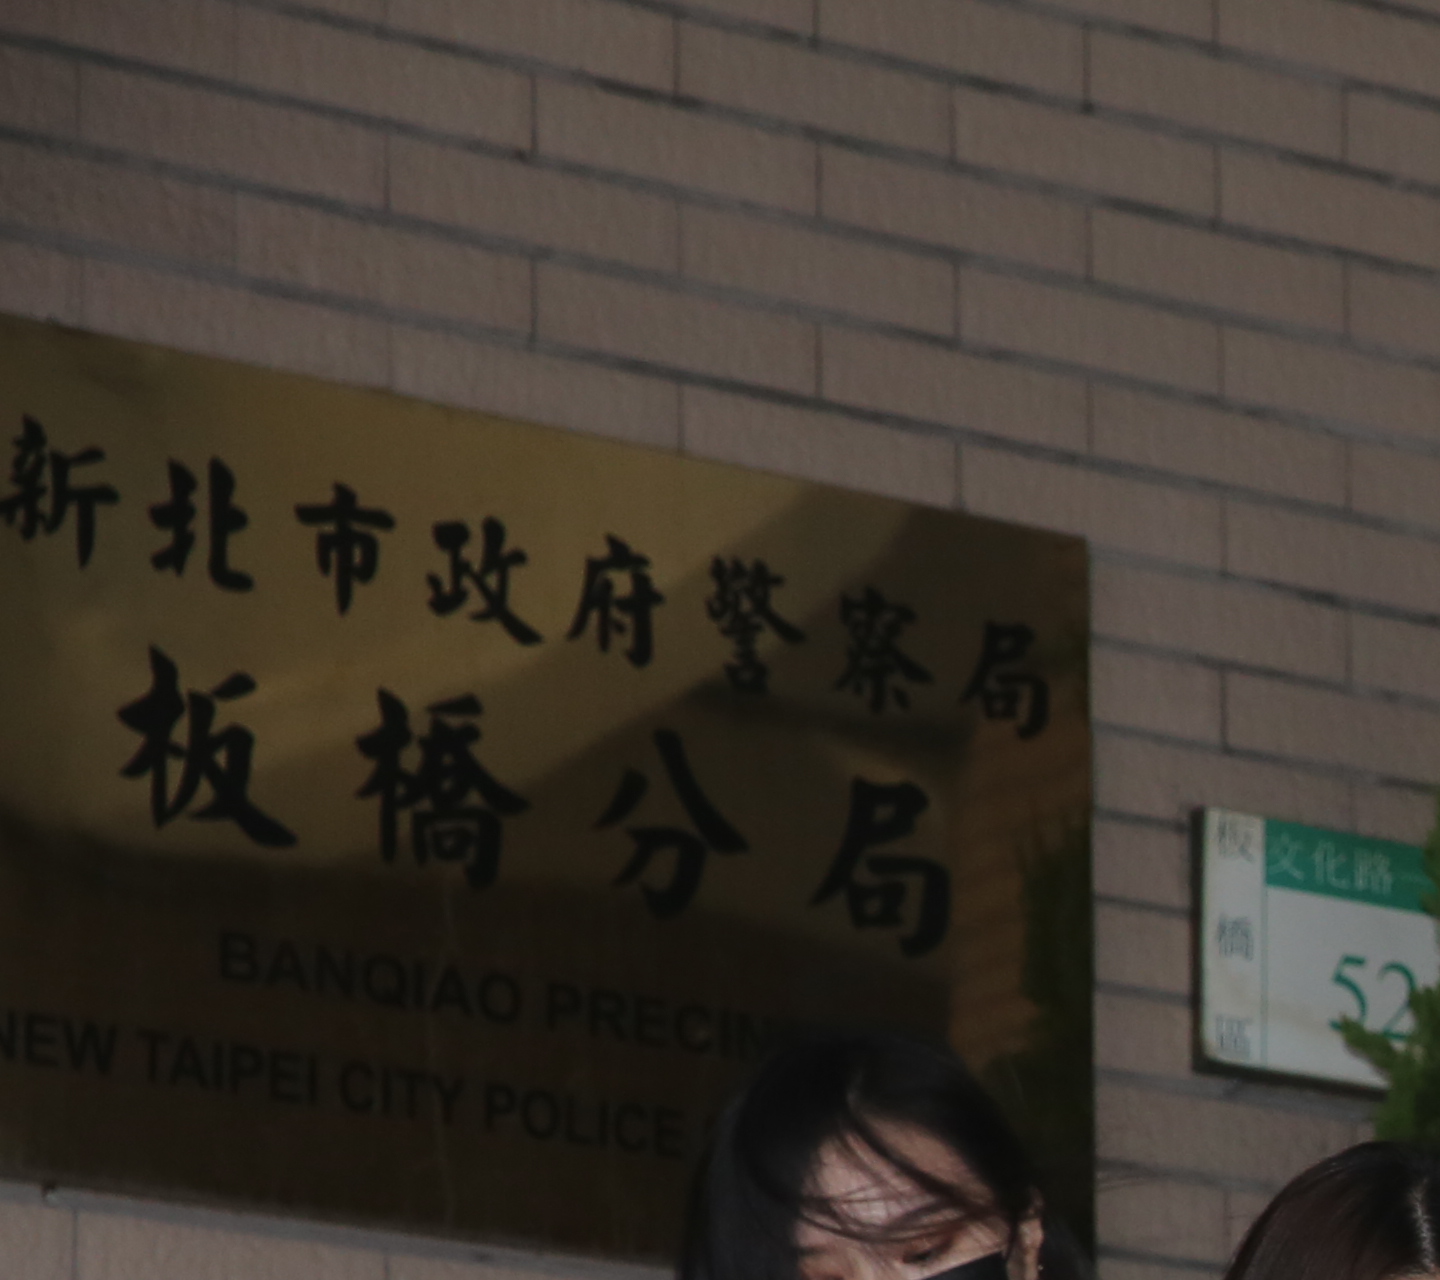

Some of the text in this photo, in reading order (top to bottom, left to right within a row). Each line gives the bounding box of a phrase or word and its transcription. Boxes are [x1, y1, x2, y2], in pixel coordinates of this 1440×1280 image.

[0, 414, 1053, 741] 新北市政府警察局
[116, 643, 954, 960] 板橋分局
[0, 1009, 119, 1077] NEW
[136, 1027, 319, 1108] TAIPEI
[338, 1059, 466, 1126] CITY
[484, 1082, 686, 1160] POLICE
[218, 928, 776, 1062] BANQIAO PRECIN
